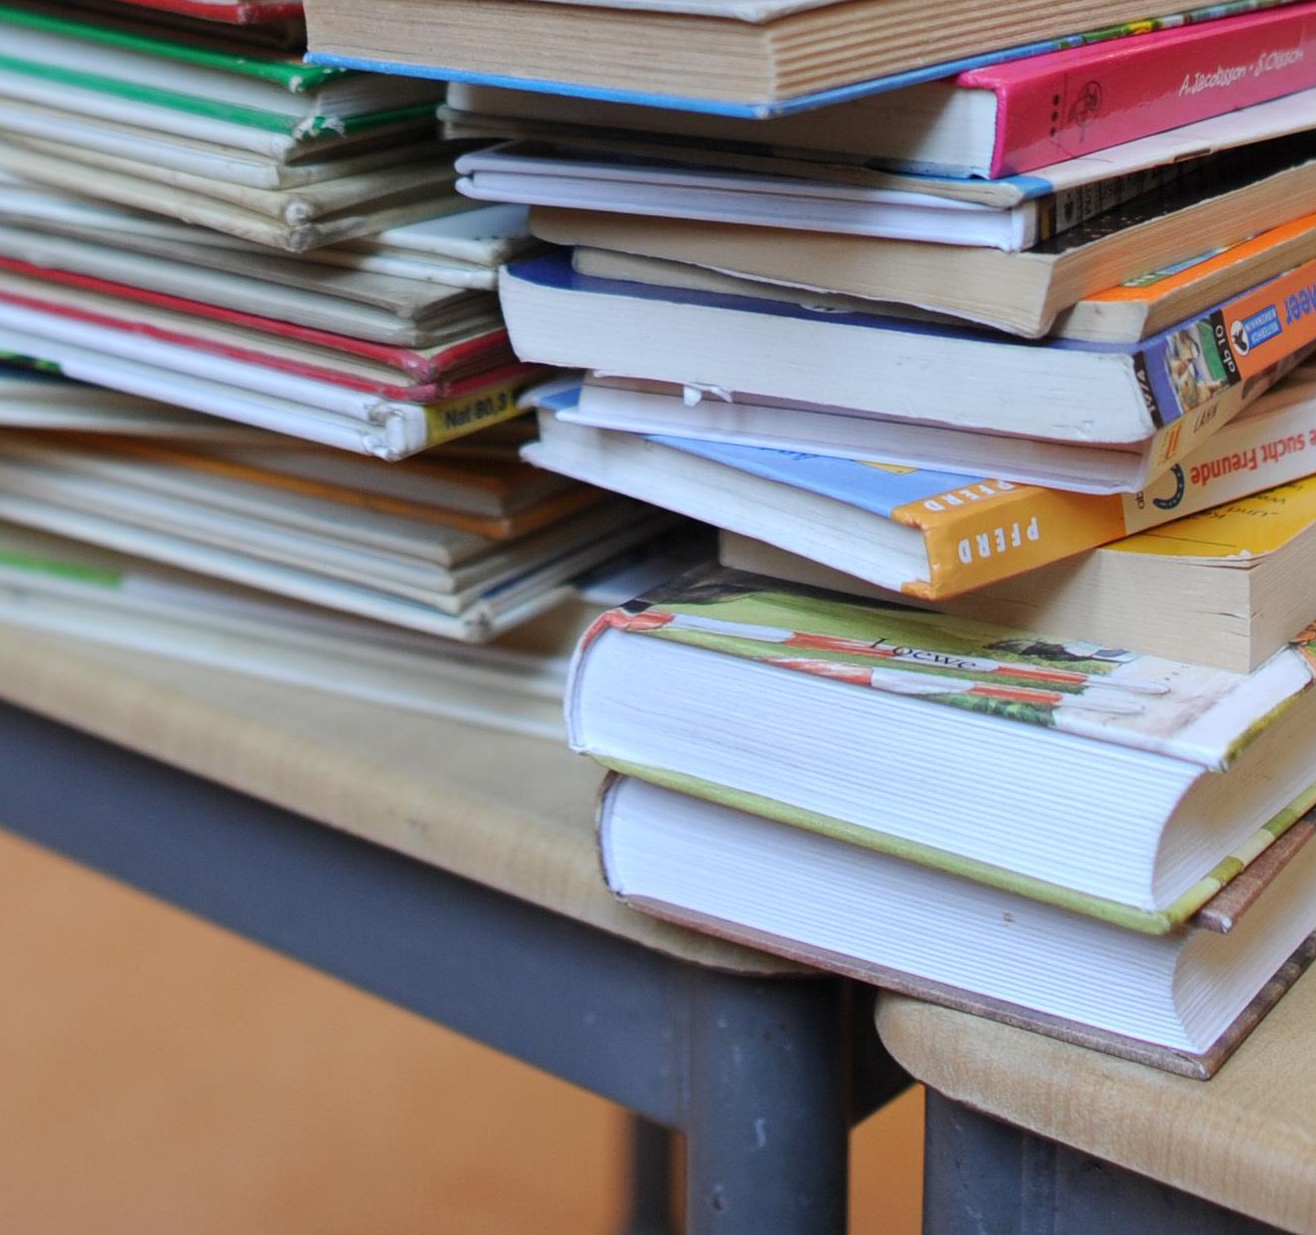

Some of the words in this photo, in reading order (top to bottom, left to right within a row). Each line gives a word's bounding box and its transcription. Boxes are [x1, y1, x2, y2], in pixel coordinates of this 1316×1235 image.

[1215, 323, 1229, 349] 10
[1223, 349, 1236, 374] ab
[1259, 433, 1306, 465] sucht
[1189, 448, 1258, 487] Freunde
[923, 480, 1013, 513] PFERD
[956, 517, 1040, 564] PFERD
[869, 637, 976, 669] Loewe
